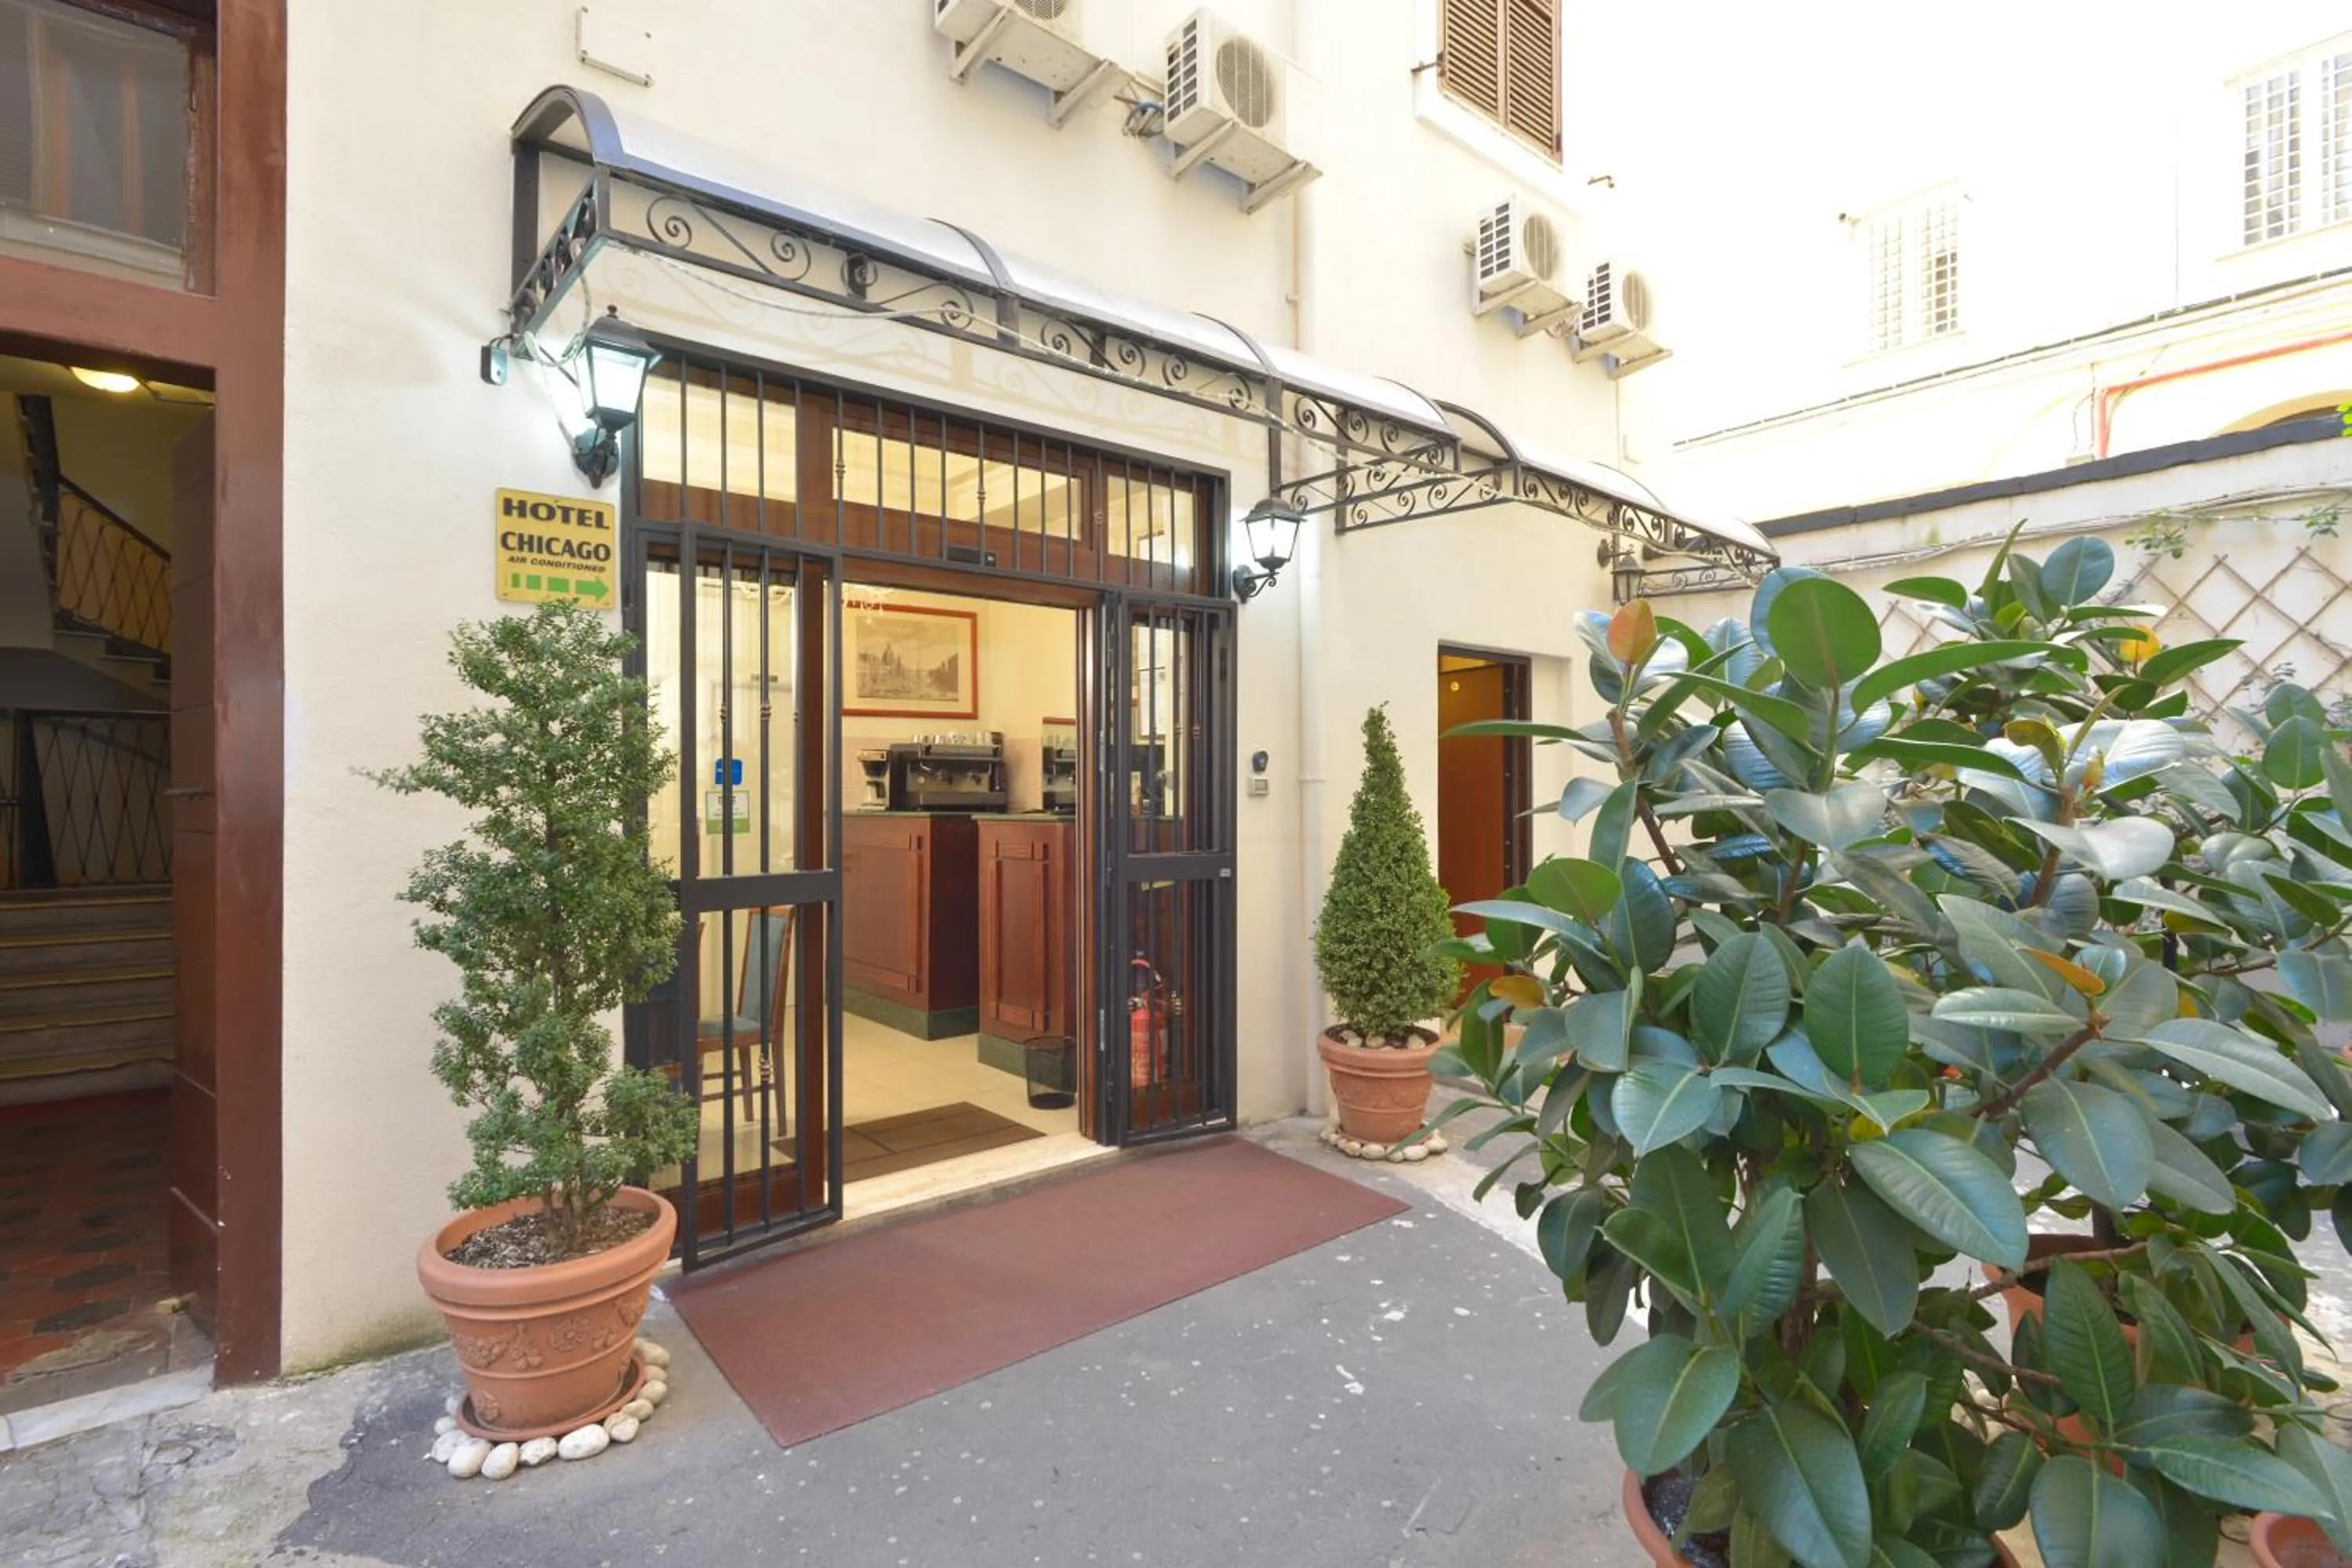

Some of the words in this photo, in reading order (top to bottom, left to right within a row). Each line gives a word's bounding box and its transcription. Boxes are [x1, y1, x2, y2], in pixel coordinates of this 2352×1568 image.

[503, 498, 610, 529] HOTEL
[501, 531, 611, 562] CHICAGO
[508, 555, 527, 564] AIR
[530, 557, 606, 573] CONDITIONED
